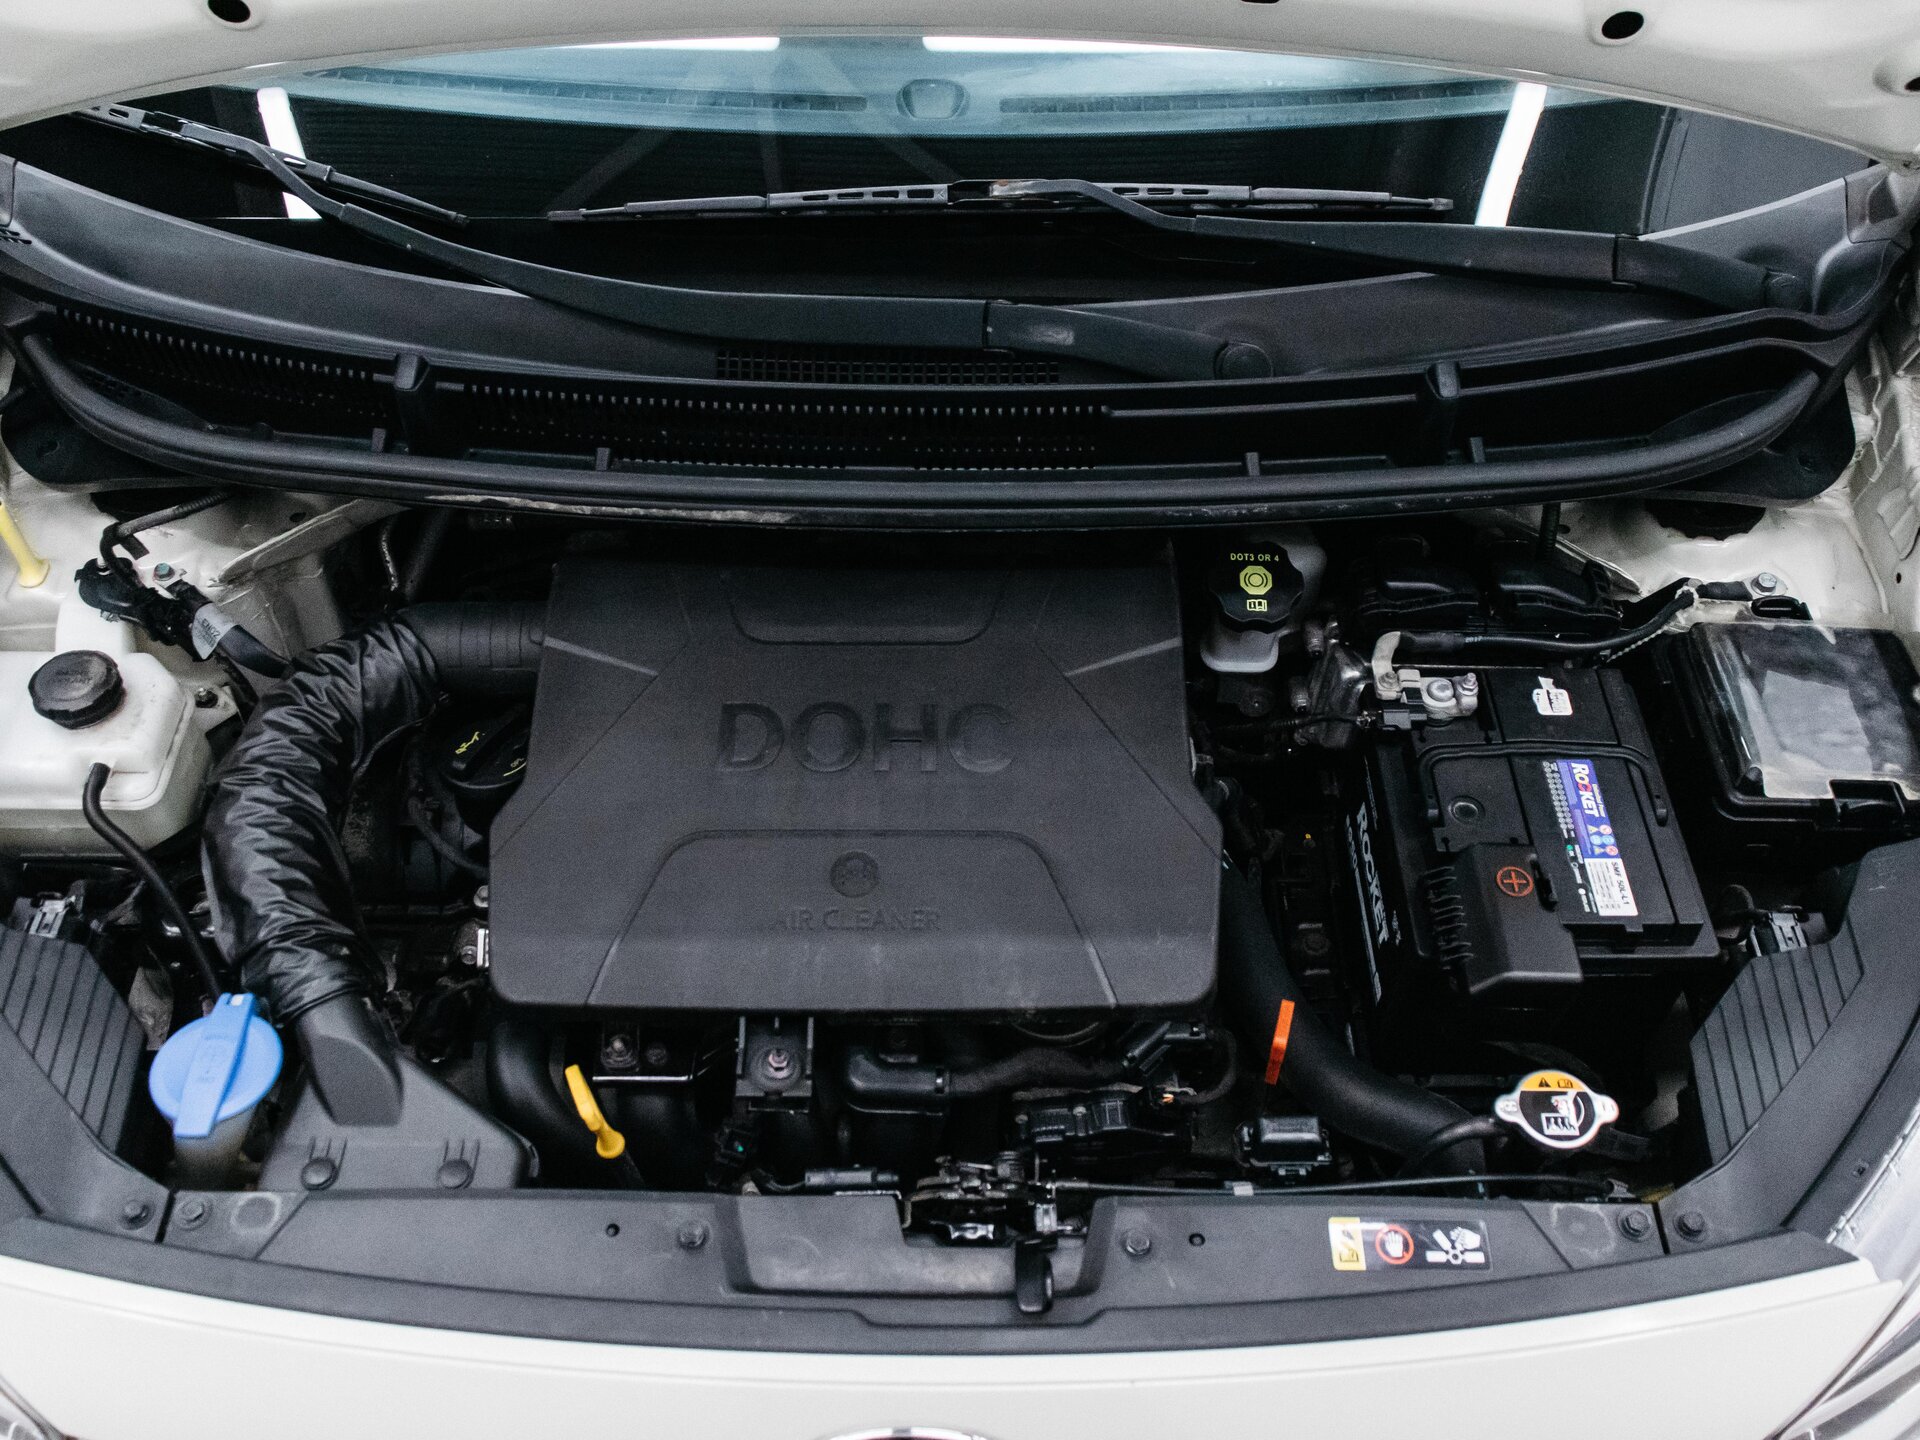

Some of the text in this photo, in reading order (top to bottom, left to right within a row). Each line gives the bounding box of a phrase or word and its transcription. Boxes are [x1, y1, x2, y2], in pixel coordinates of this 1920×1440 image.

[1230, 553, 1255, 561] DOT3
[1257, 554, 1271, 562] OR
[716, 702, 1015, 773] DOHC
[1357, 802, 1389, 948] ROCKET
[770, 908, 941, 932] AIR CLEANER
